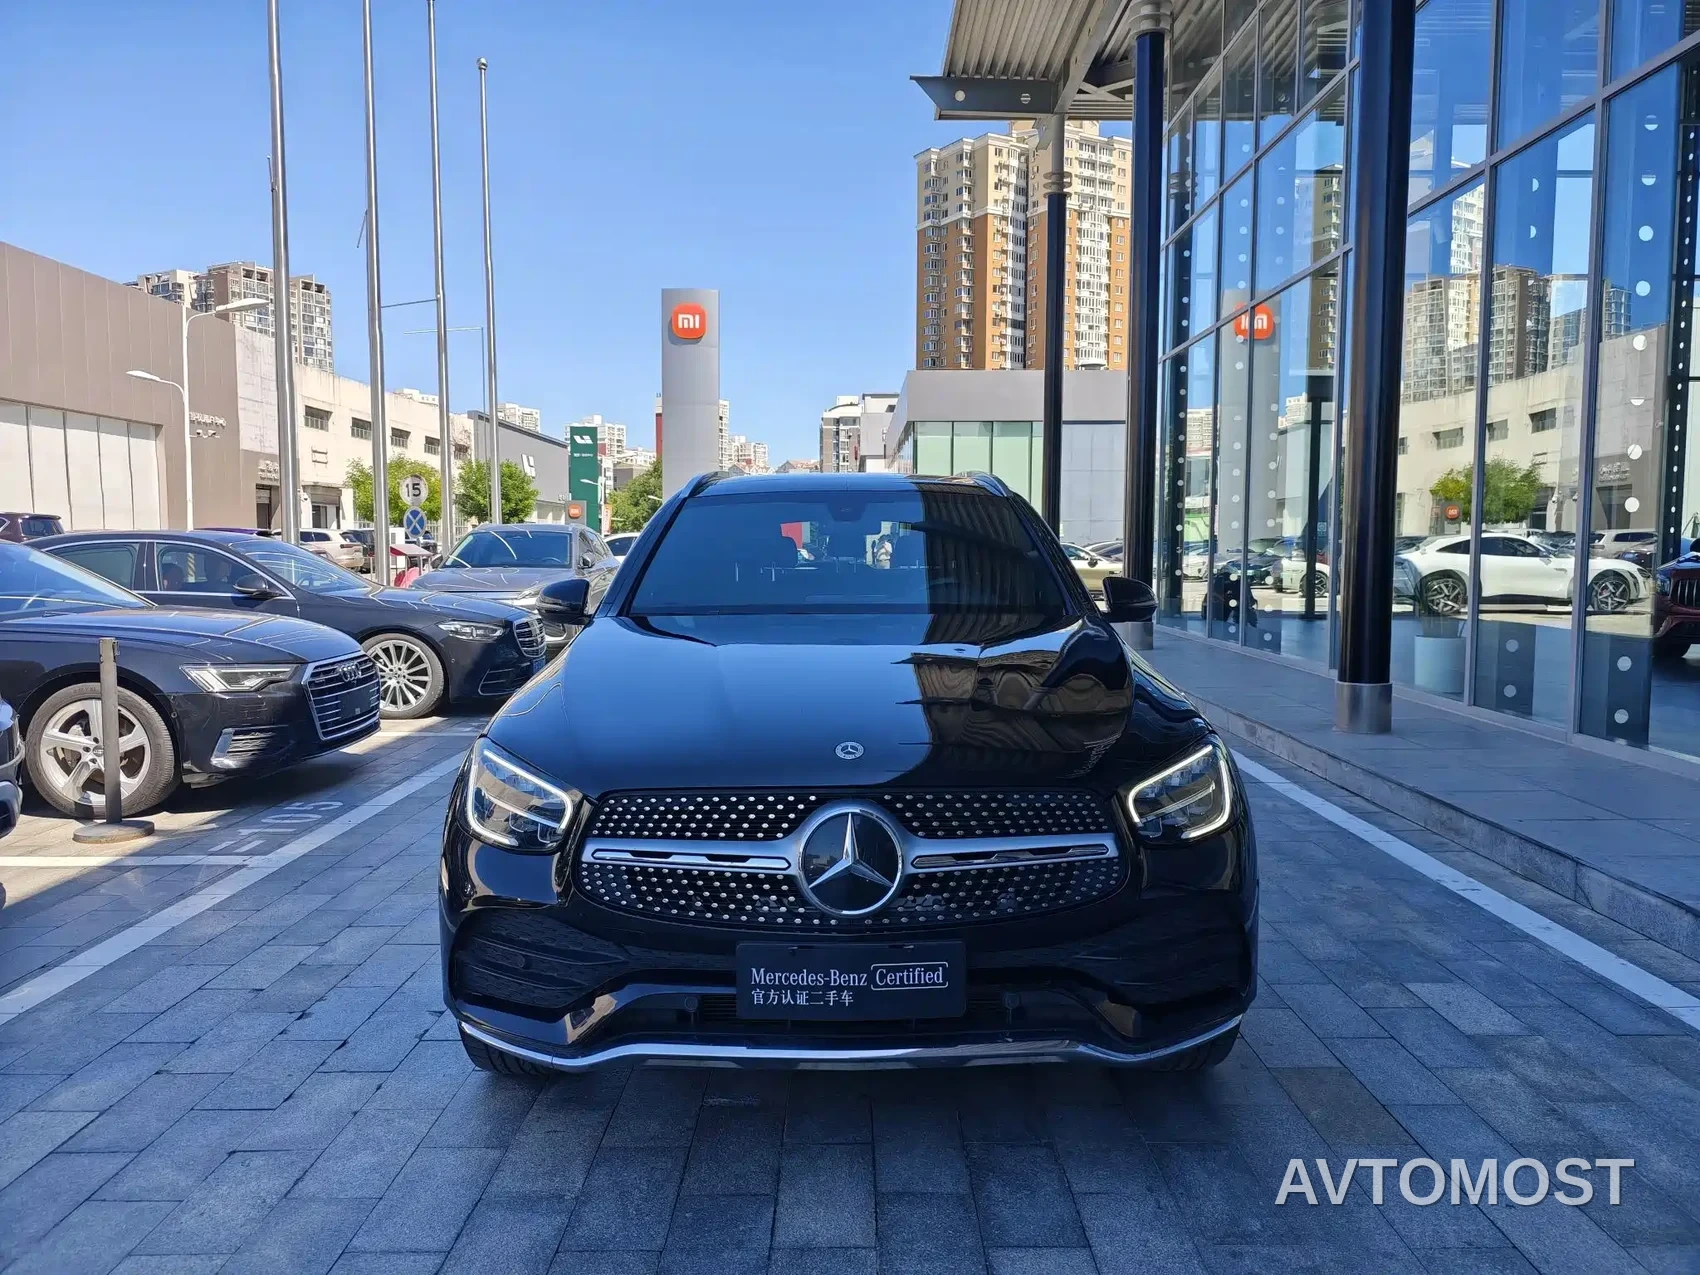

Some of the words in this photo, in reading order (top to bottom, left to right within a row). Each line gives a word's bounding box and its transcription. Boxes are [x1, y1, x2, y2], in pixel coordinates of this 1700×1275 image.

[406, 483, 422, 497] 15
[750, 967, 868, 986] Mercedes-Benz
[876, 966, 943, 986] Certified
[751, 988, 854, 1007] 官方认证二手车
